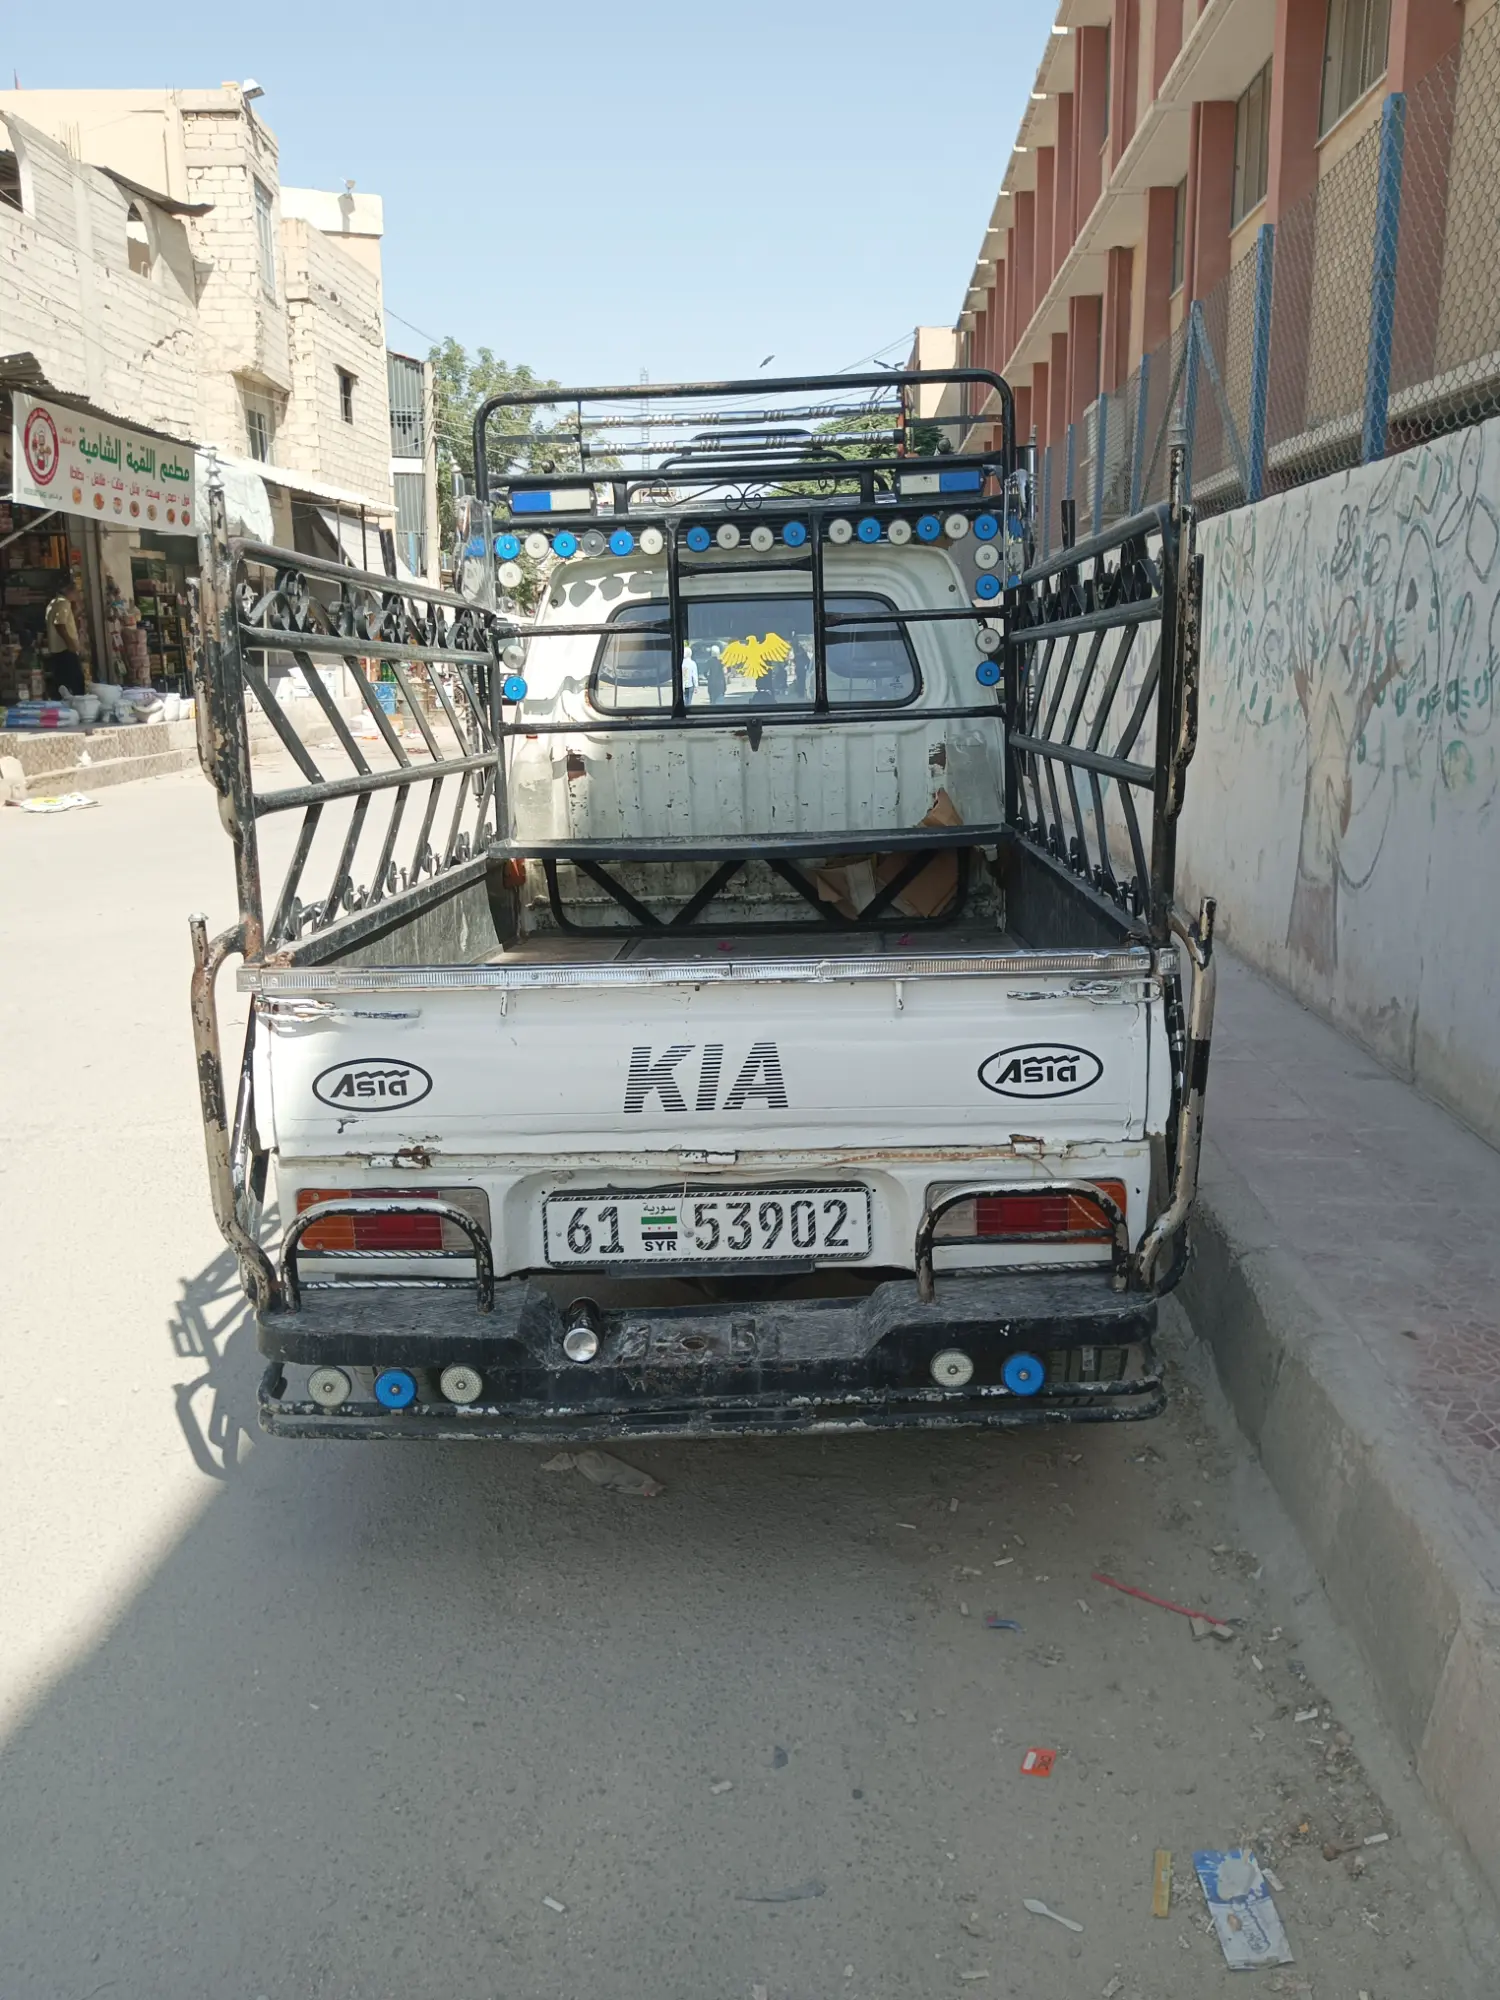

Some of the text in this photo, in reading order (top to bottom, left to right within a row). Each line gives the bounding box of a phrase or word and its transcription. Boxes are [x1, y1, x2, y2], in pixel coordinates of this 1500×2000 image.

[78, 427, 122, 472] الشامية
[126, 443, 156, 481] اللقمة
[160, 456, 190, 483] مطعم
[329, 1069, 410, 1098] Asia
[623, 1042, 789, 1113] KIA
[995, 1055, 1080, 1084] Asia
[643, 1202, 676, 1215] سورية
[567, 1199, 849, 1254] 61 53902
[644, 1241, 677, 1252] SYR
